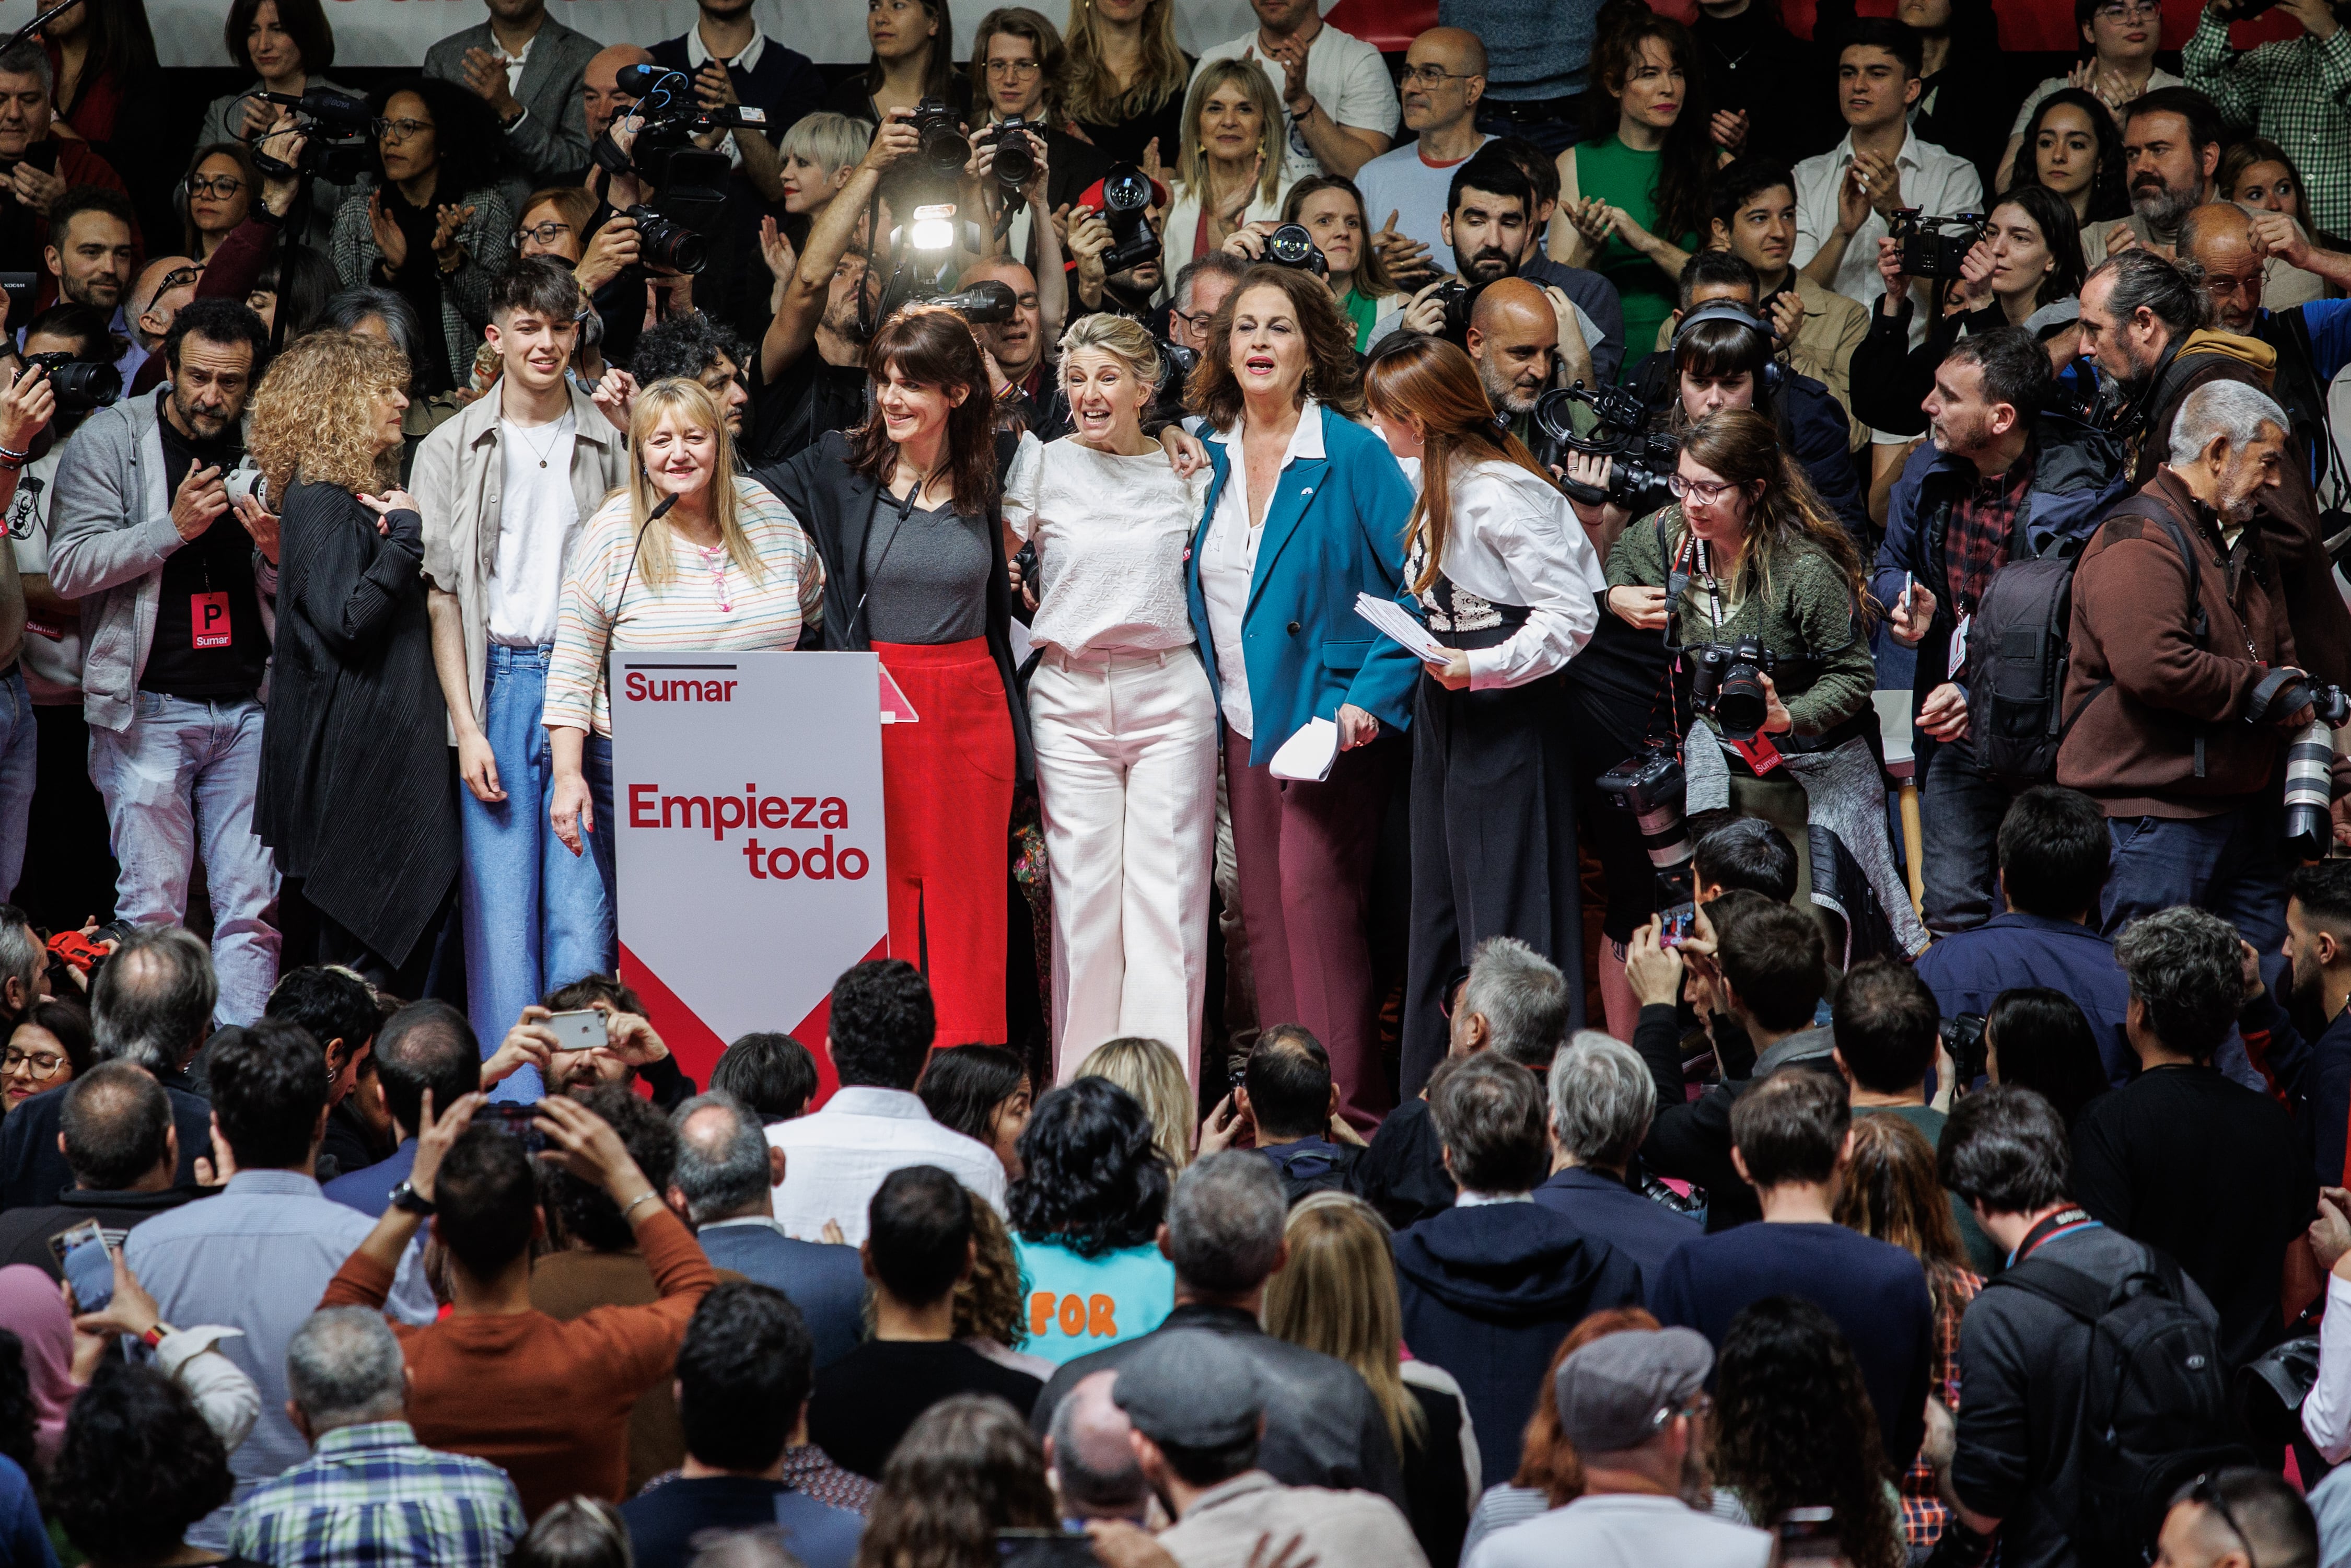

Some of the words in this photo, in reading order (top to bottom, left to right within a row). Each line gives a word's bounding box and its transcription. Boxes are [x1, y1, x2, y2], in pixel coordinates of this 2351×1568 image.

[330, 99, 351, 109] BOYA
[204, 604, 222, 630] P
[1711, 596, 1723, 622] LONDON
[27, 621, 59, 634] Sumar
[196, 636, 228, 646] Sumar
[625, 672, 738, 702] Sumar
[1755, 754, 1780, 773] Sumar
[629, 783, 848, 841] Empieza
[742, 834, 869, 880] todo
[1030, 1292, 1117, 1337] FOR
